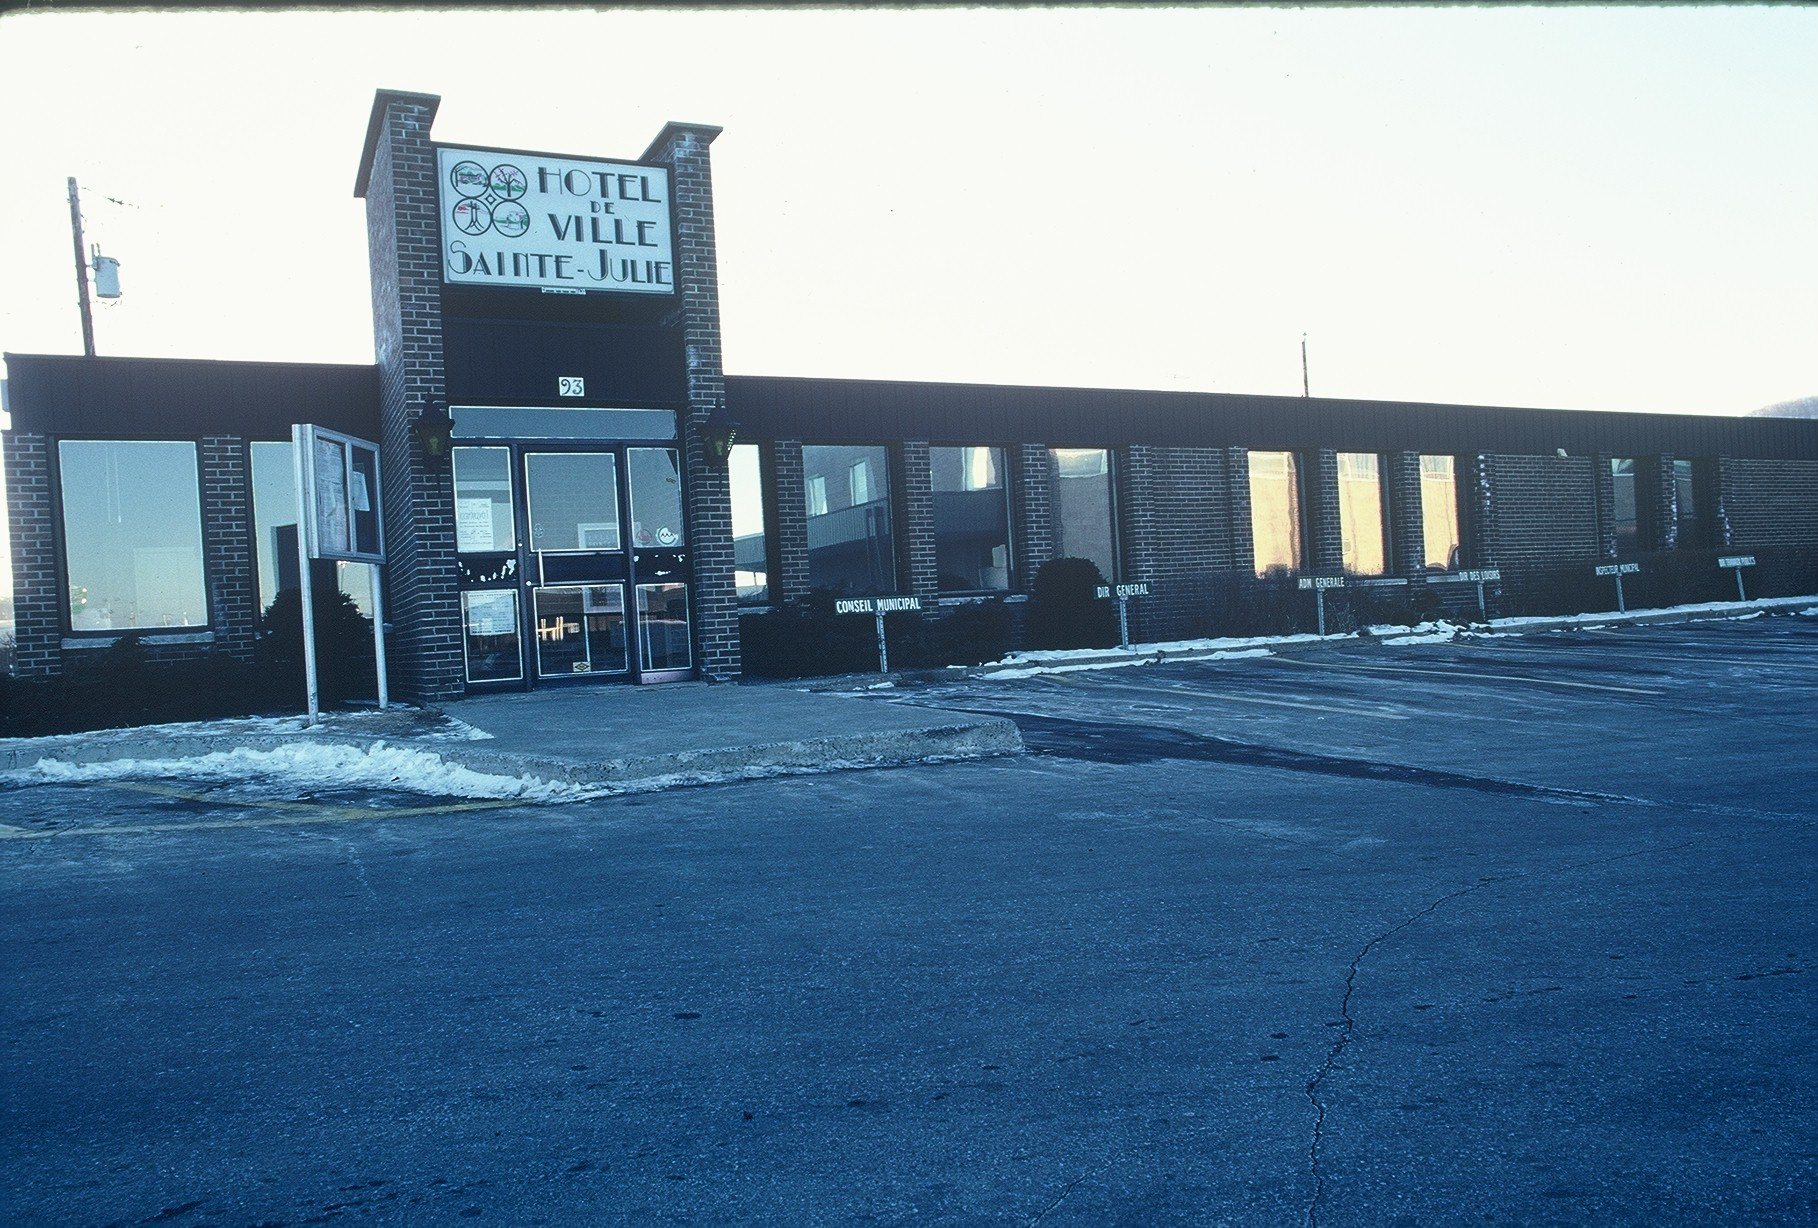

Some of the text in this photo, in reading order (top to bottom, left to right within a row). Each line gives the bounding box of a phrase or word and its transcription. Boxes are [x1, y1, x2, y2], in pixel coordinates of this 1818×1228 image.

[537, 166, 662, 203] HOTEL
[590, 200, 615, 215] DE
[547, 213, 658, 247] VILLE
[561, 379, 583, 396] 93
[1315, 576, 1345, 588] GENERALE
[1097, 583, 1149, 598] DIR GENERAL
[836, 597, 921, 613] CONSEIL MUNICIPAL
